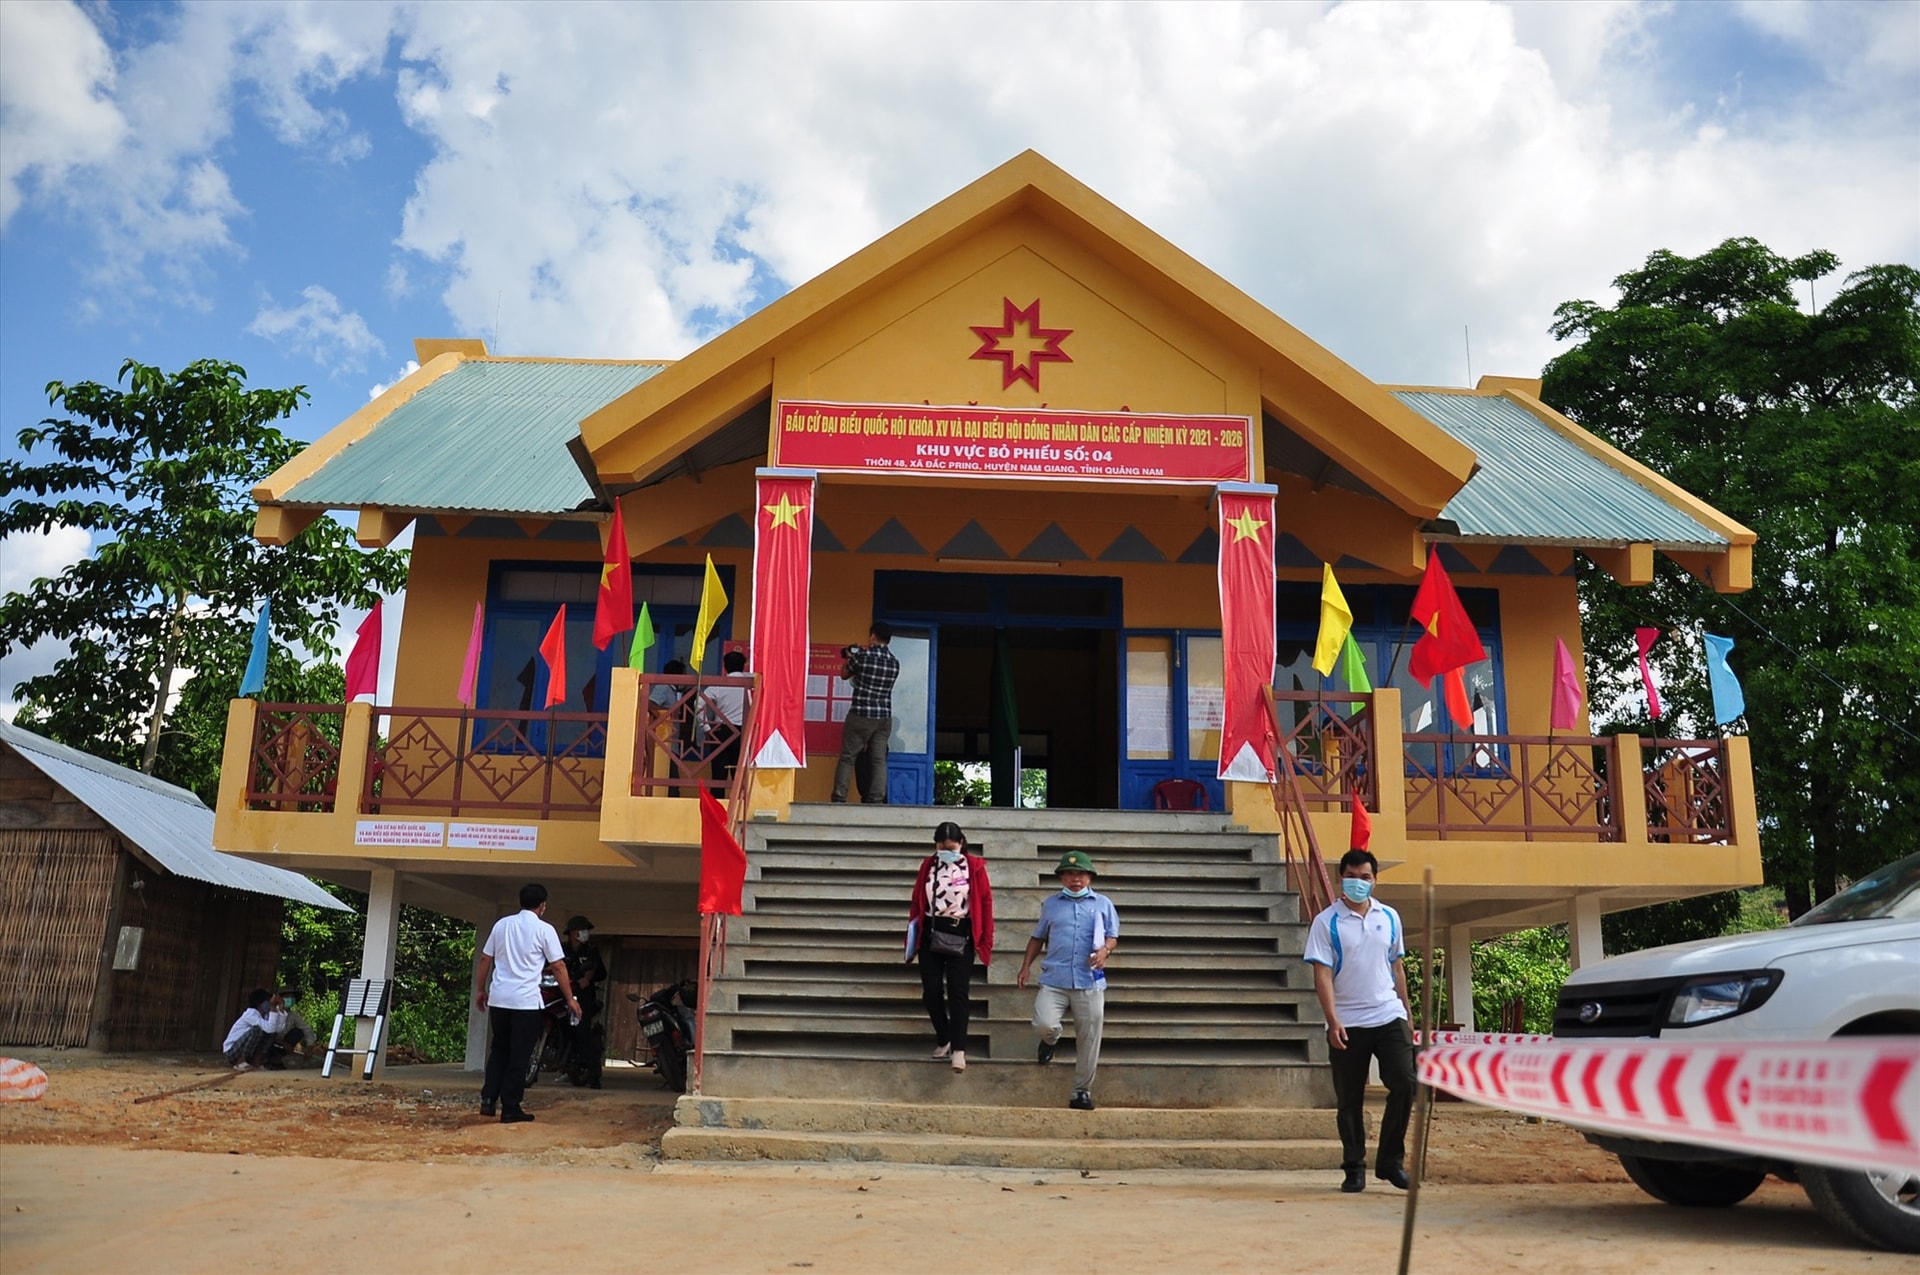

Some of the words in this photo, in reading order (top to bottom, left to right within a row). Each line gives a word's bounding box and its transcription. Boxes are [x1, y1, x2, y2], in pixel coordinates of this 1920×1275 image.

[807, 410, 821, 432] CỬ
[822, 416, 838, 437] ĐẠI
[840, 411, 862, 434] BIỂU
[864, 412, 888, 436] QUỐC
[890, 415, 906, 439] HỘI
[908, 416, 934, 436] KHÓA
[936, 420, 948, 437] XV
[950, 416, 962, 438] VÀ
[964, 420, 980, 442] ĐẠI
[982, 415, 1004, 438] BIỂU
[1006, 419, 1022, 443] HỘI
[1024, 418, 1050, 440] ĐỒNG
[1052, 420, 1078, 442] NHÂN
[1080, 422, 1100, 442] DÂN
[1102, 422, 1120, 443] CÁC
[1122, 420, 1141, 444] CẤP
[1144, 424, 1174, 448] NHIỆM
[1176, 425, 1188, 445] KỲ
[1190, 428, 1211, 446] 2021
[1220, 430, 1243, 447] 2026
[916, 444, 950, 456] KHU
[954, 444, 985, 460] VỰC
[988, 444, 1010, 458] BỎ
[1013, 444, 1060, 460] PHIẾU
[1064, 445, 1090, 461] SỐ:
[1092, 450, 1112, 461] 04
[864, 458, 891, 466] THÔN
[910, 459, 923, 467] XÃ
[984, 462, 1018, 472] HUYỆN
[1020, 464, 1041, 472] NAM
[1081, 464, 1102, 473] TỈNH
[1105, 465, 1140, 475] QUẢNG
[1142, 468, 1163, 476] NAM
